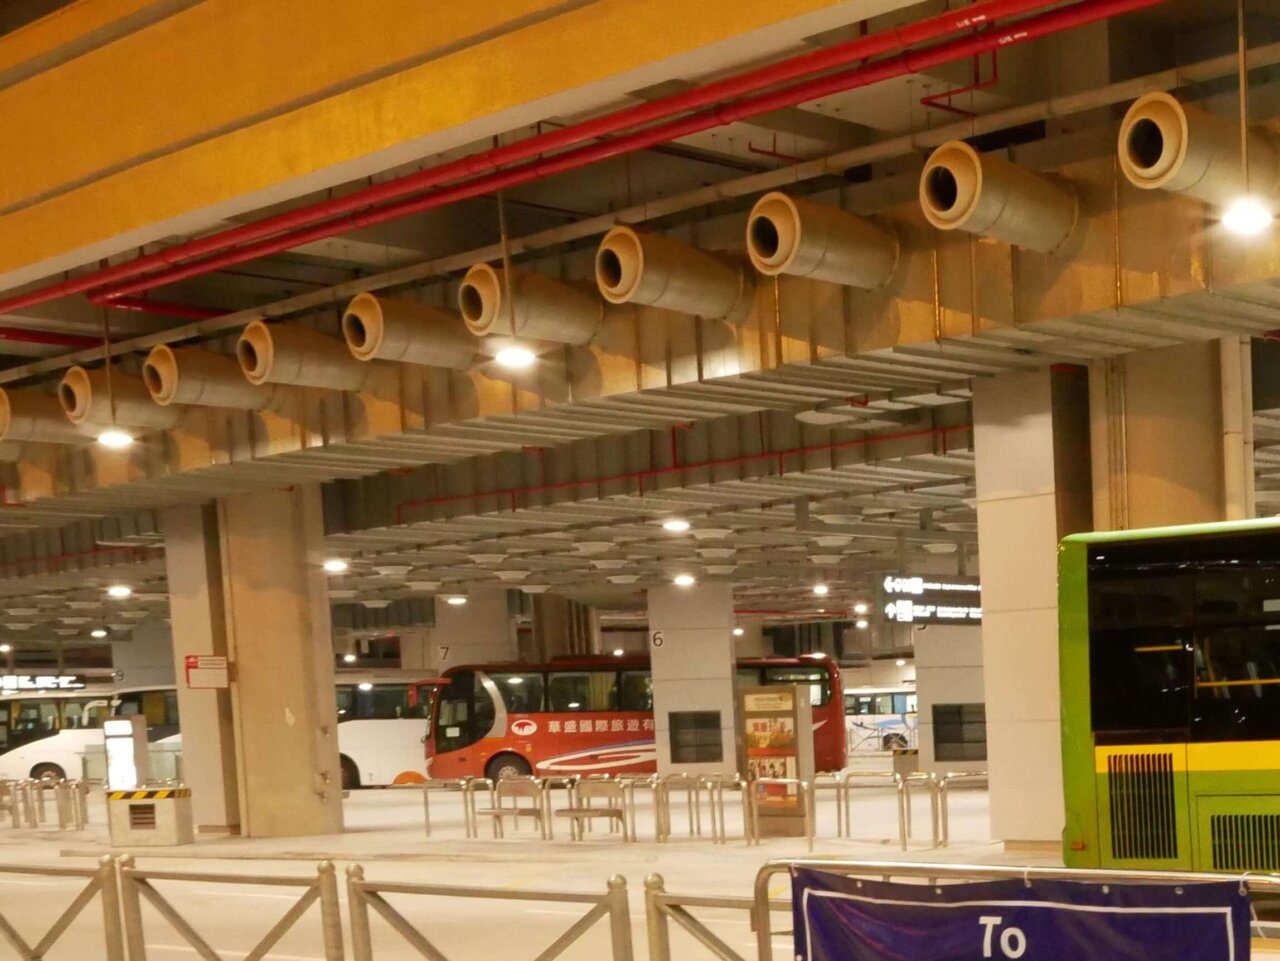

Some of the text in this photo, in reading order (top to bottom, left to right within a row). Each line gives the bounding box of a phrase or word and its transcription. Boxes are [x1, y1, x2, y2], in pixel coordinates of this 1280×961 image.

[653, 631, 664, 647] 6
[440, 646, 449, 660] 7
[115, 669, 124, 681] 9
[979, 916, 1026, 958] To
